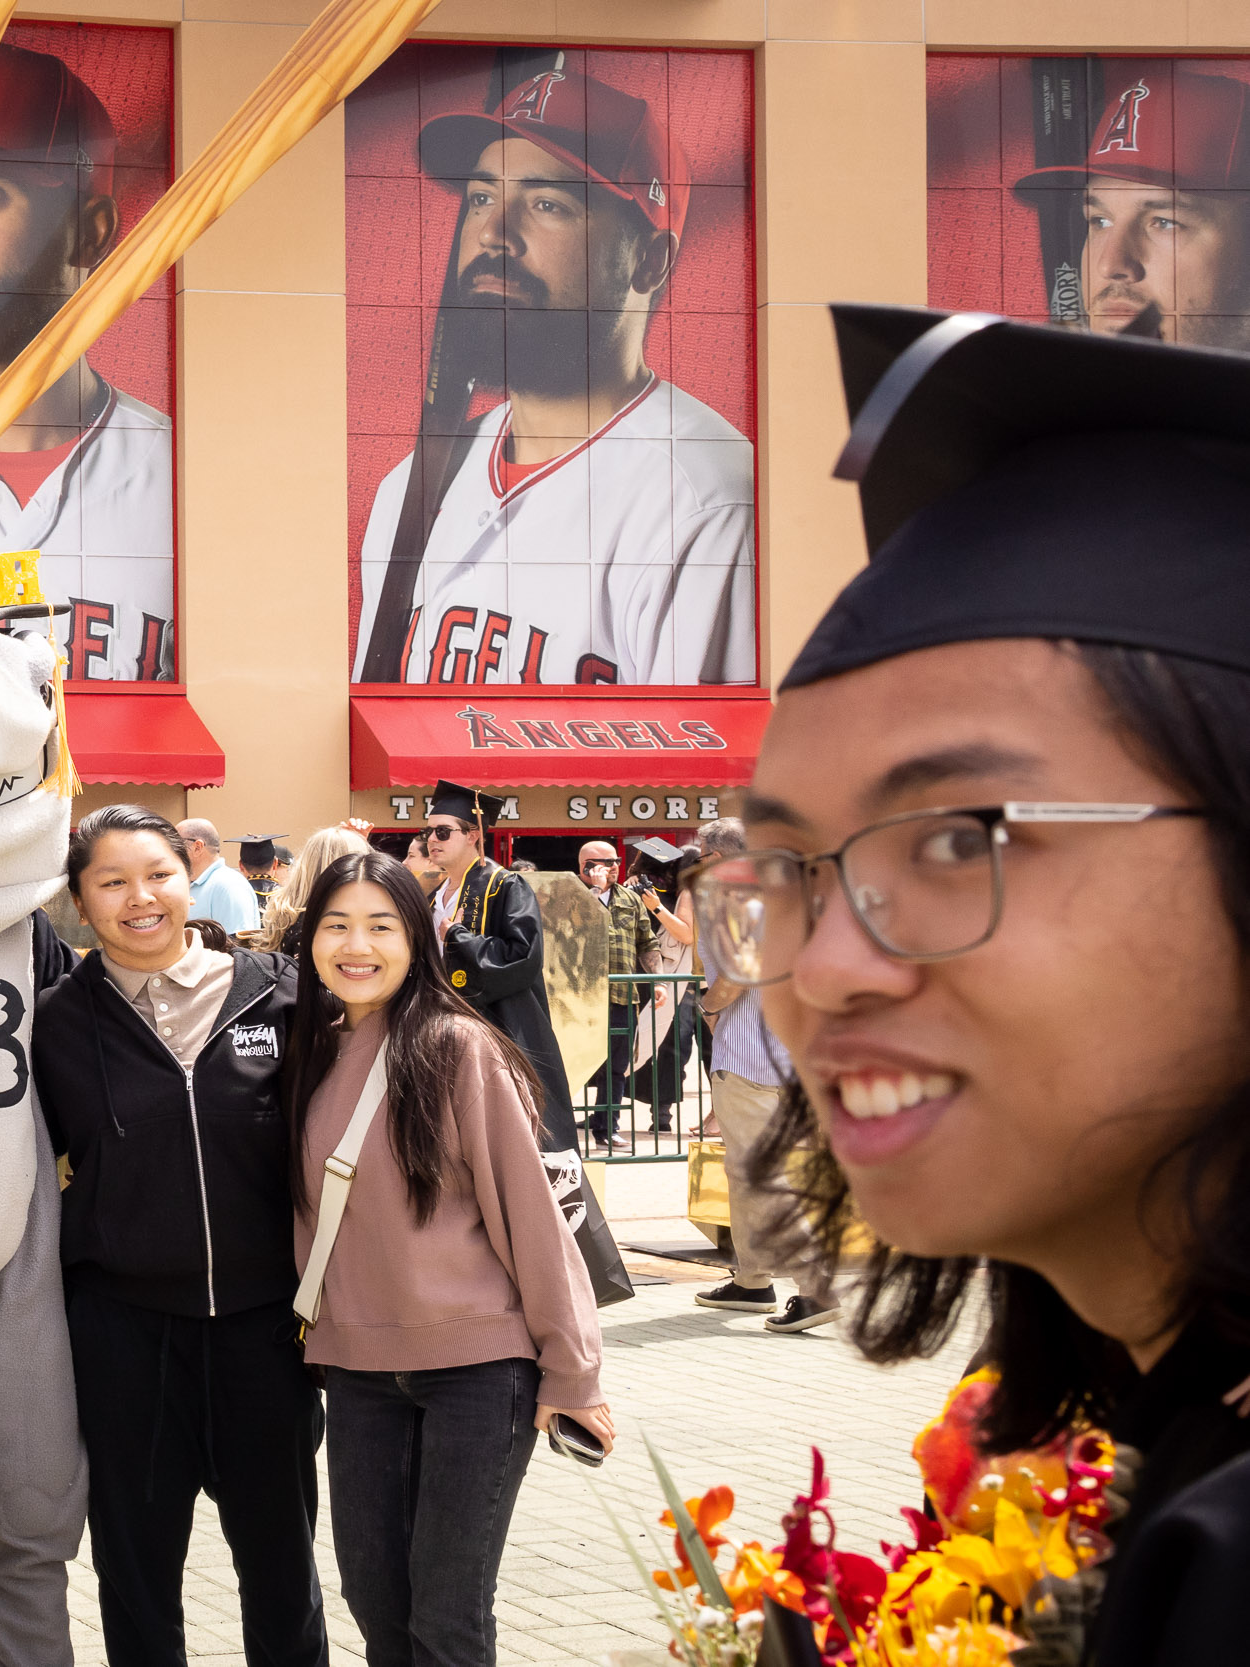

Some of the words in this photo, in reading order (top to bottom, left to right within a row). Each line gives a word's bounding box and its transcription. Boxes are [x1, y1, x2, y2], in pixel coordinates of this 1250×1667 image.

[455, 704, 728, 750] ANGELS
[391, 795, 521, 820] TM
[567, 796, 719, 820] STORE
